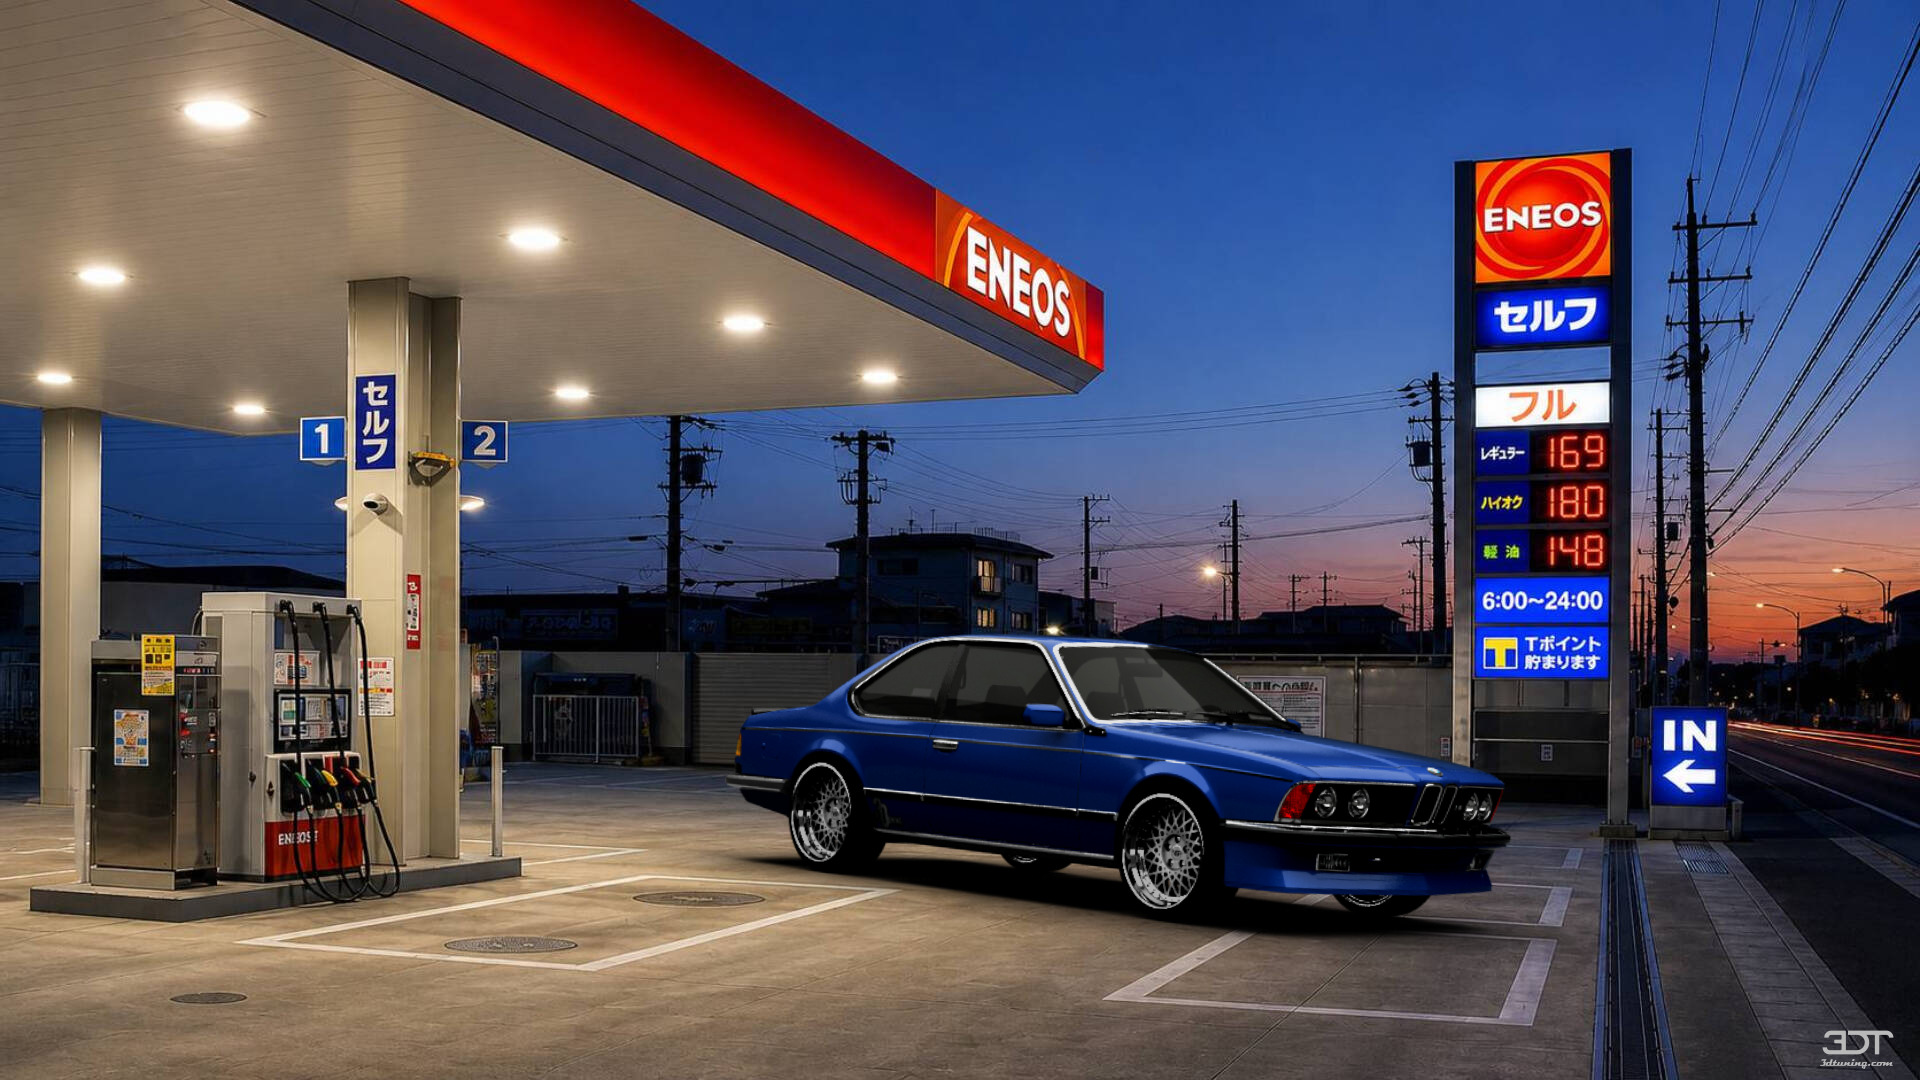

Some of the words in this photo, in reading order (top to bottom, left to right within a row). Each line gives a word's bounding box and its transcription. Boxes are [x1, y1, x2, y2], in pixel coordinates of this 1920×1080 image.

[1484, 201, 1602, 232] ENEOS
[967, 226, 1070, 337] ENEOS
[1494, 297, 1597, 333] セルフ
[1508, 389, 1577, 422] フル
[314, 423, 329, 454] 1
[363, 381, 389, 464] セルフ
[474, 425, 496, 456] 2
[1481, 446, 1525, 461] レギュラー
[1549, 435, 1604, 469] 169
[1481, 495, 1523, 510] ハイオク
[1549, 485, 1604, 519] 180
[1549, 534, 1604, 567] 148
[1525, 635, 1601, 652] Tポイント
[1525, 655, 1601, 670] 貯まります
[1663, 720, 1717, 752] IN
